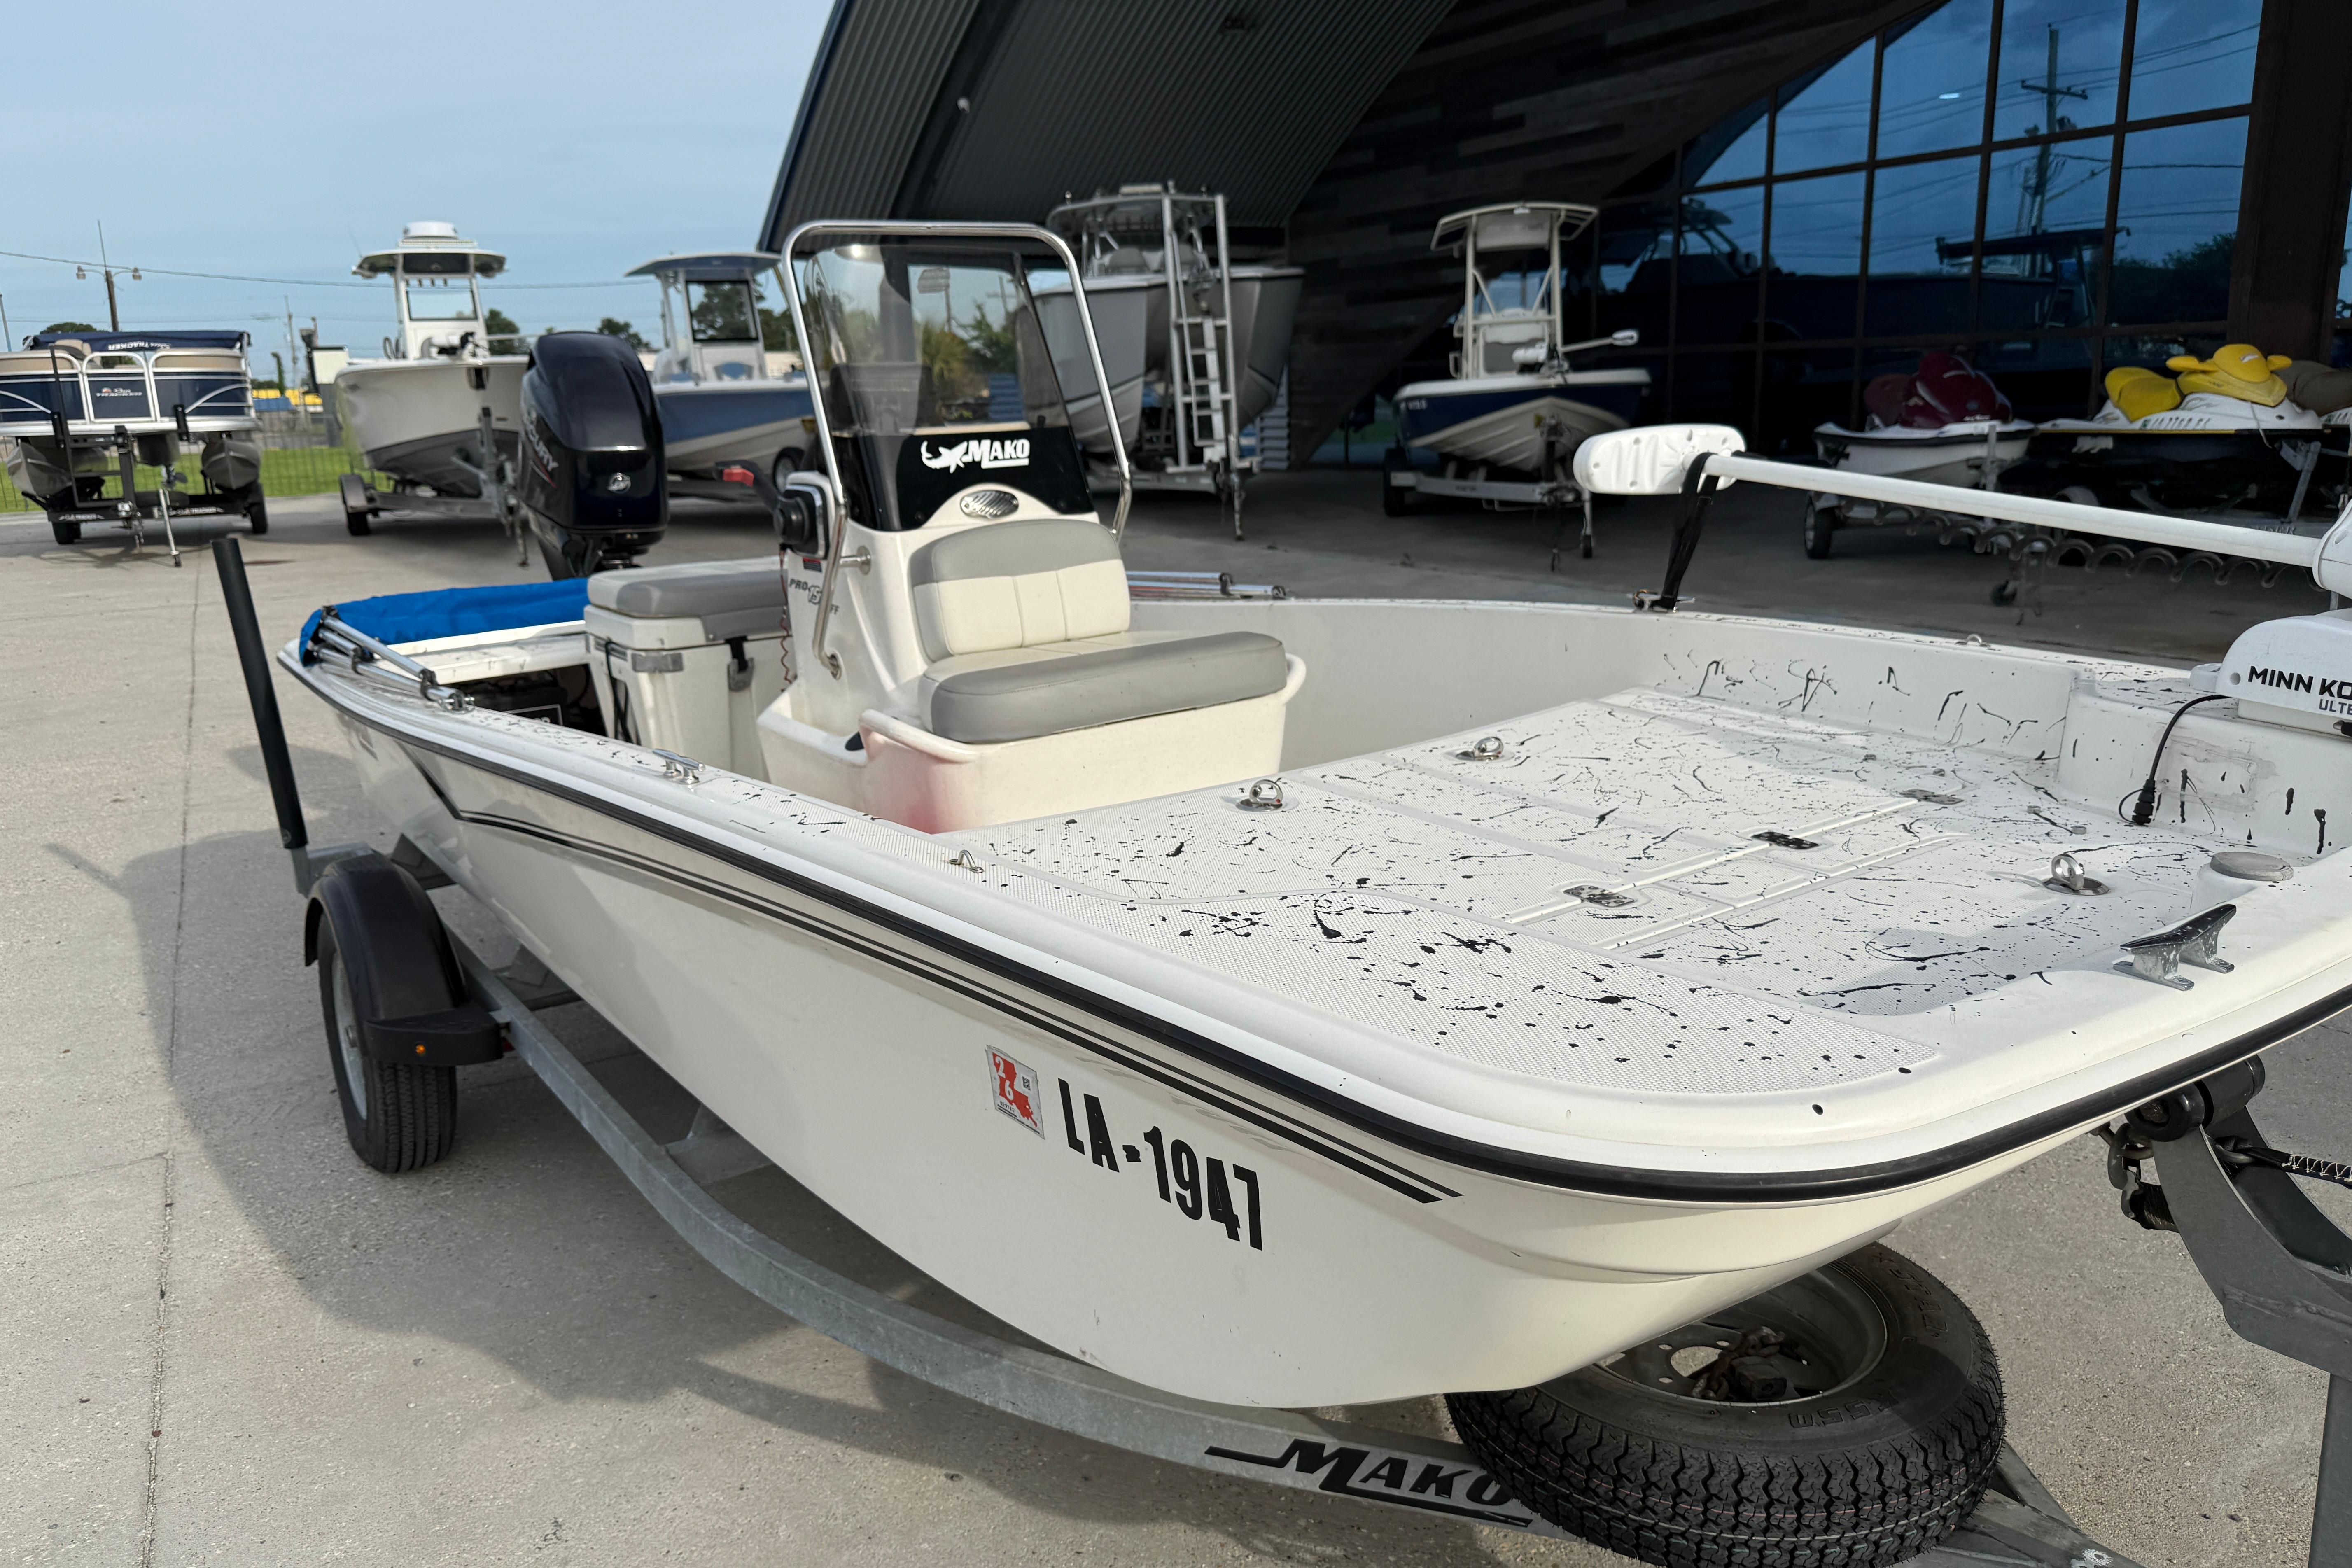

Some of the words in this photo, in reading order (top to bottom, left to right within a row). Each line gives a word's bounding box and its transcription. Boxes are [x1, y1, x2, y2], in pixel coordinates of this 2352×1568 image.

[961, 439, 1030, 469] MAKO
[789, 578, 809, 591] PRO
[2248, 665, 2314, 693] MINN
[1058, 1078, 1262, 1251] LA-1947
[1204, 1438, 1533, 1528] MAKO
